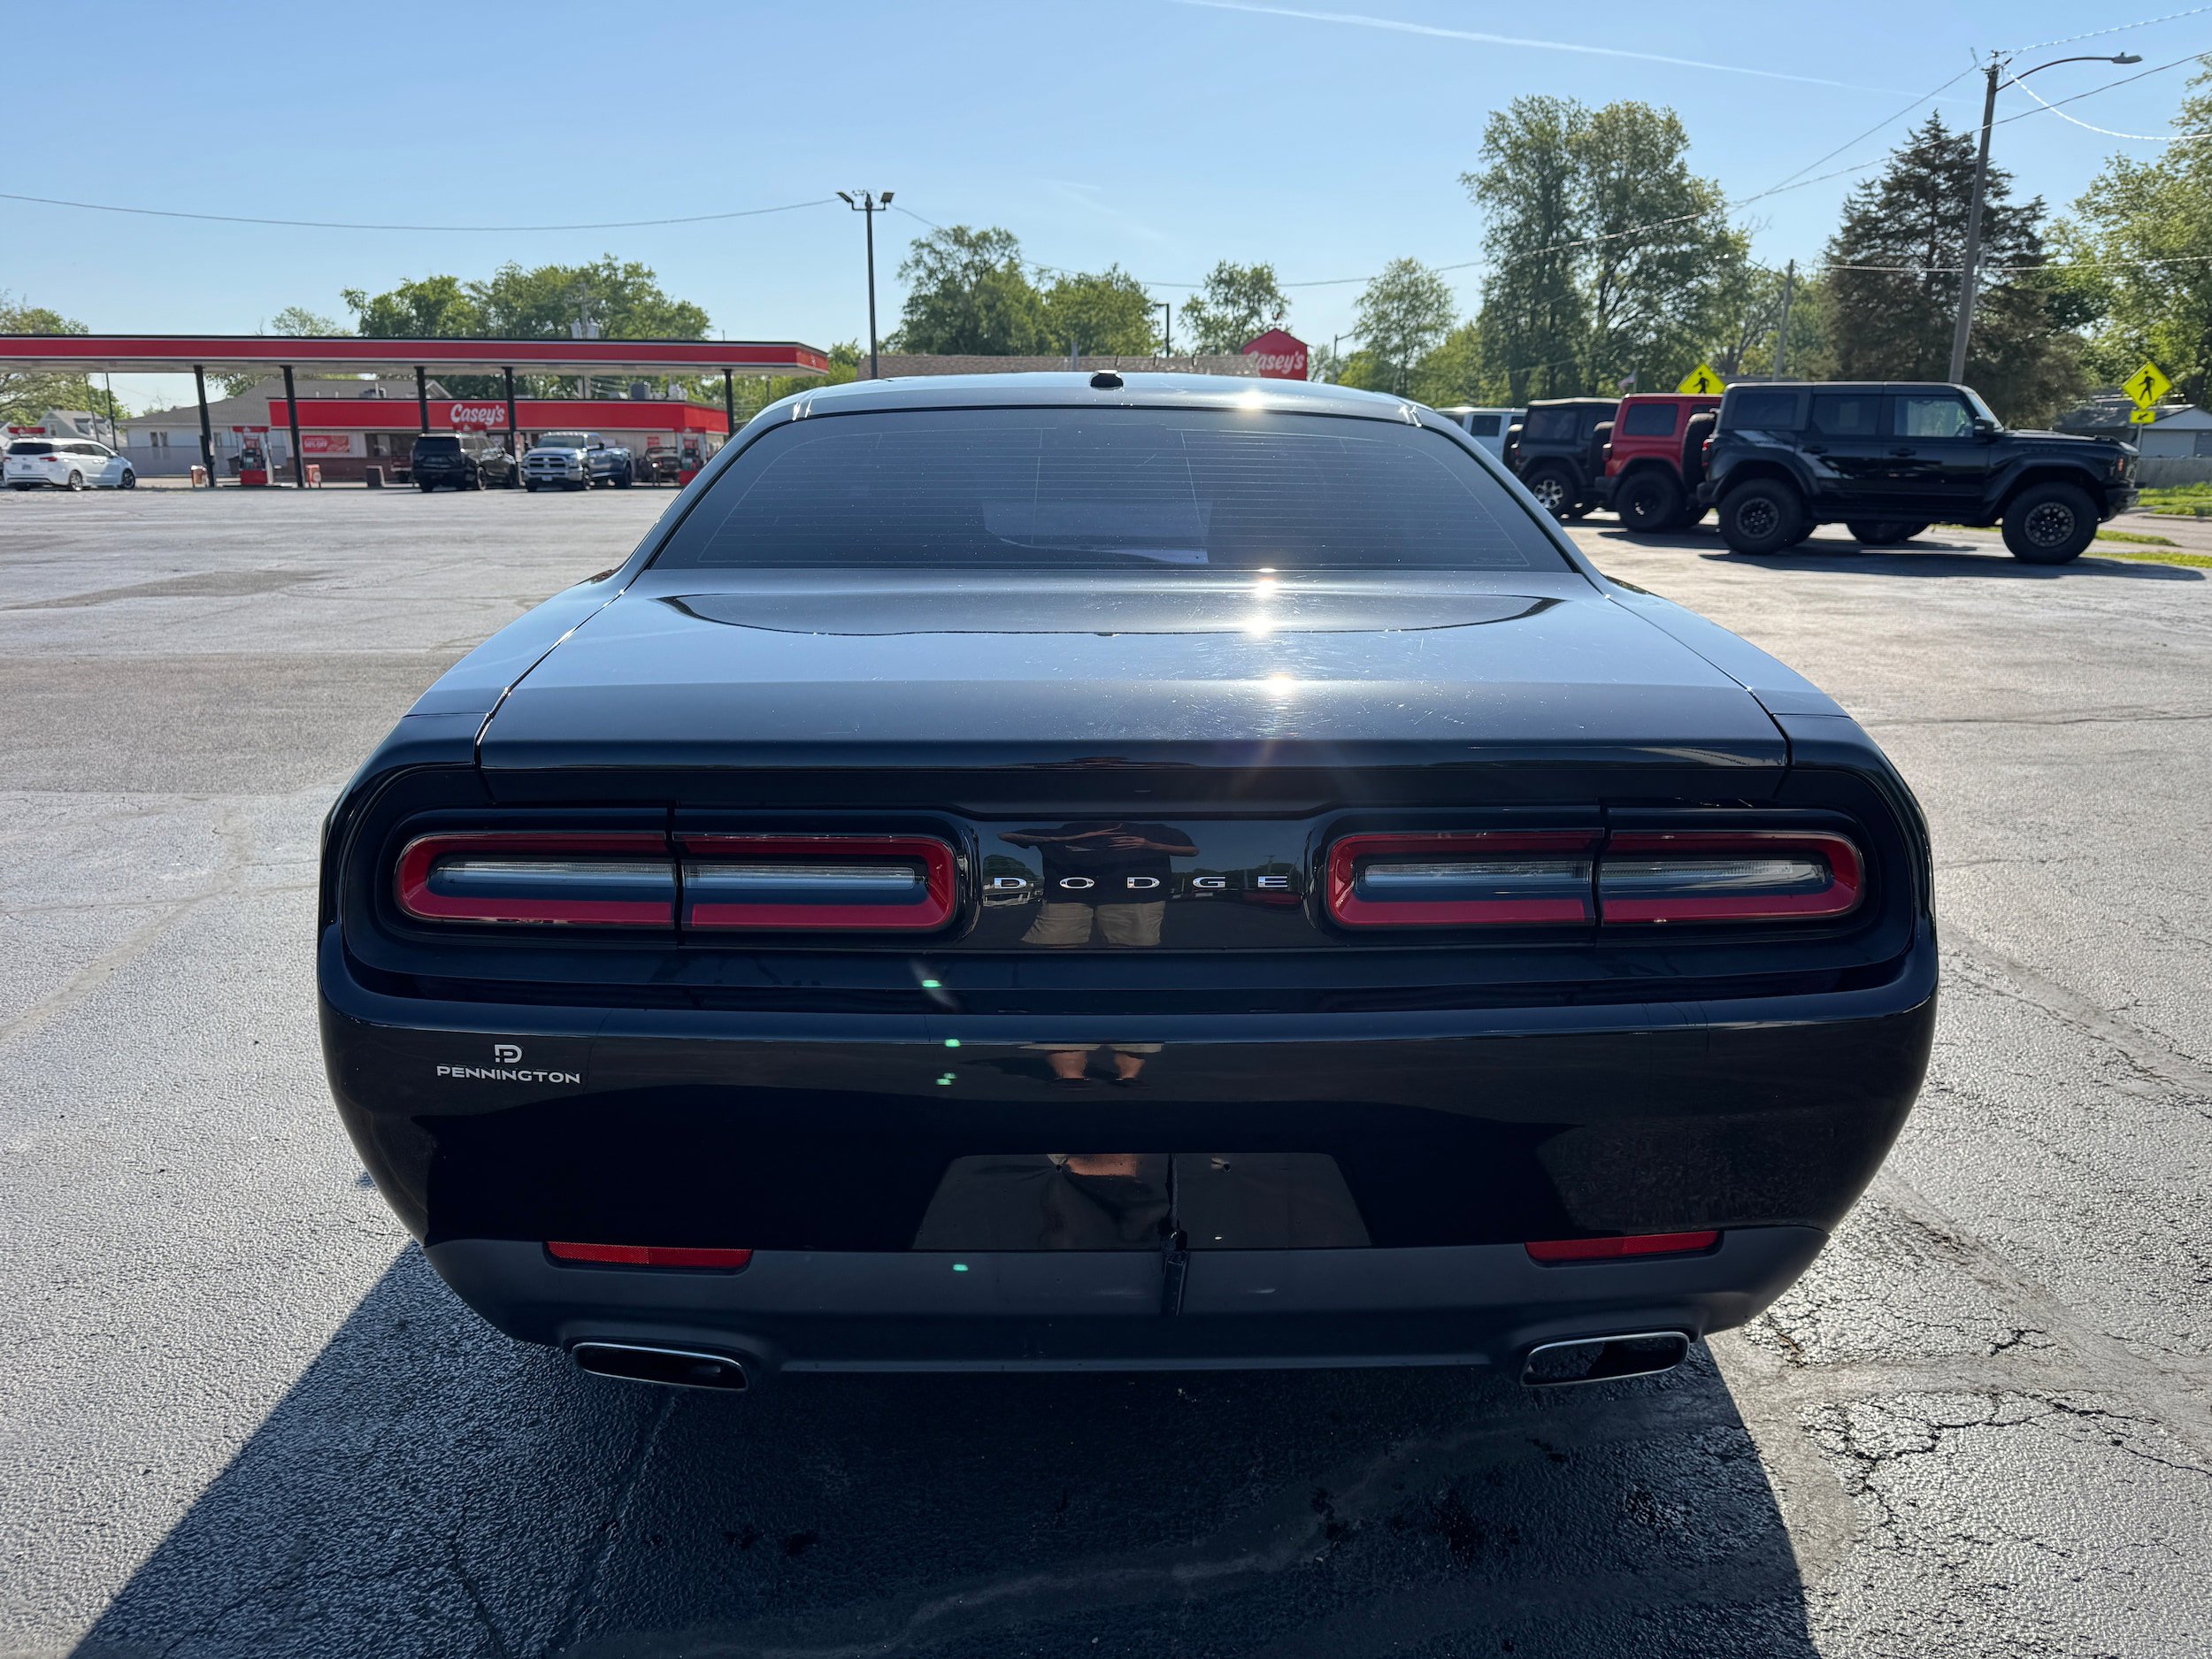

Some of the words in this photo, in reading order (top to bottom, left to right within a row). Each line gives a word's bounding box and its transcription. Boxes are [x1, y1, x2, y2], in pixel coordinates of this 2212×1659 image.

[449, 403, 505, 426] Casey's
[993, 876, 1288, 889] DODGE
[436, 1065, 581, 1084] PENNINGTON
